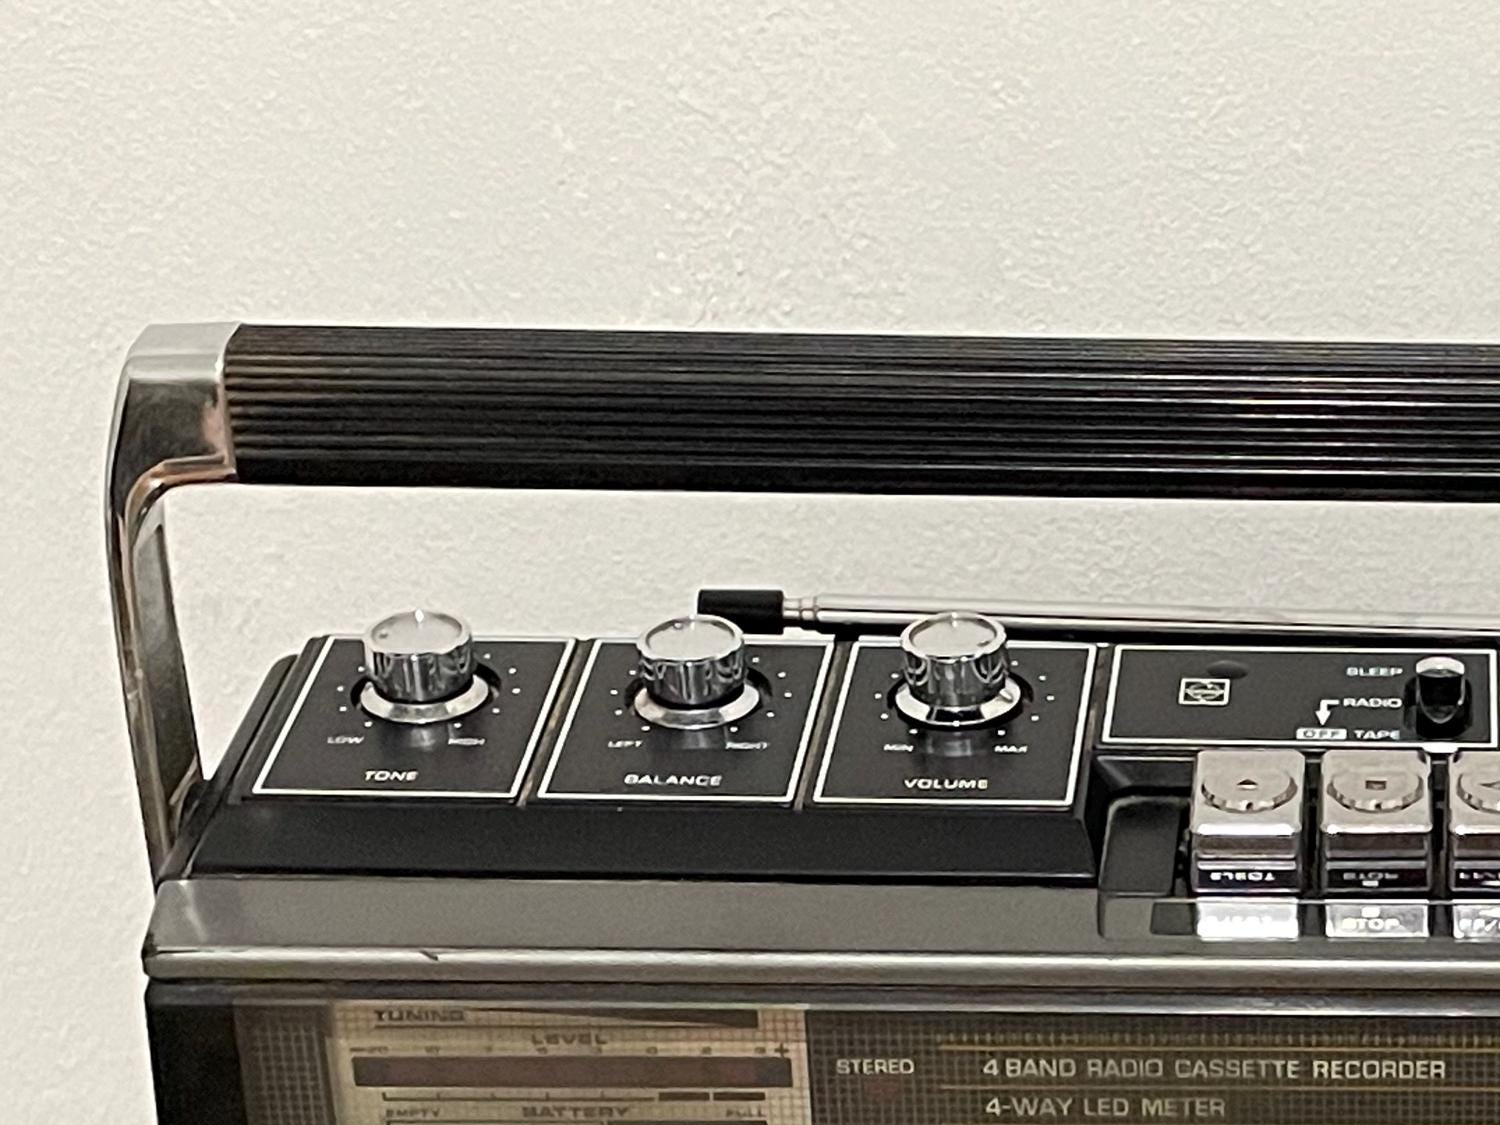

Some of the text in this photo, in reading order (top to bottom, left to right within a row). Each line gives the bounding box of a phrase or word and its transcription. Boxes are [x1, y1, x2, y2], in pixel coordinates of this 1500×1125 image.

[1346, 667, 1402, 677] SLEEP
[1343, 697, 1402, 708] RADIO
[327, 736, 364, 745] LOW
[1303, 729, 1401, 740] OFF TAPE
[883, 744, 914, 753] MIN
[994, 745, 1028, 754] MAX
[365, 770, 419, 782] TONE
[624, 774, 723, 786] BALANCE
[904, 779, 989, 790] VOLUME
[1341, 917, 1400, 930] STOP
[375, 1009, 466, 1022] TUNING
[531, 1033, 609, 1045] LEVEL
[836, 1059, 915, 1076] STEREO
[1005, 1059, 1077, 1079] BAND
[1087, 1059, 1164, 1079] RADIO
[1174, 1060, 1301, 1080] CASSETTE
[1313, 1060, 1447, 1080] RECORDER
[385, 1105, 766, 1119] EMPTY BATTERY FULL
[985, 1098, 1226, 1118] 4-WAY LED METER
